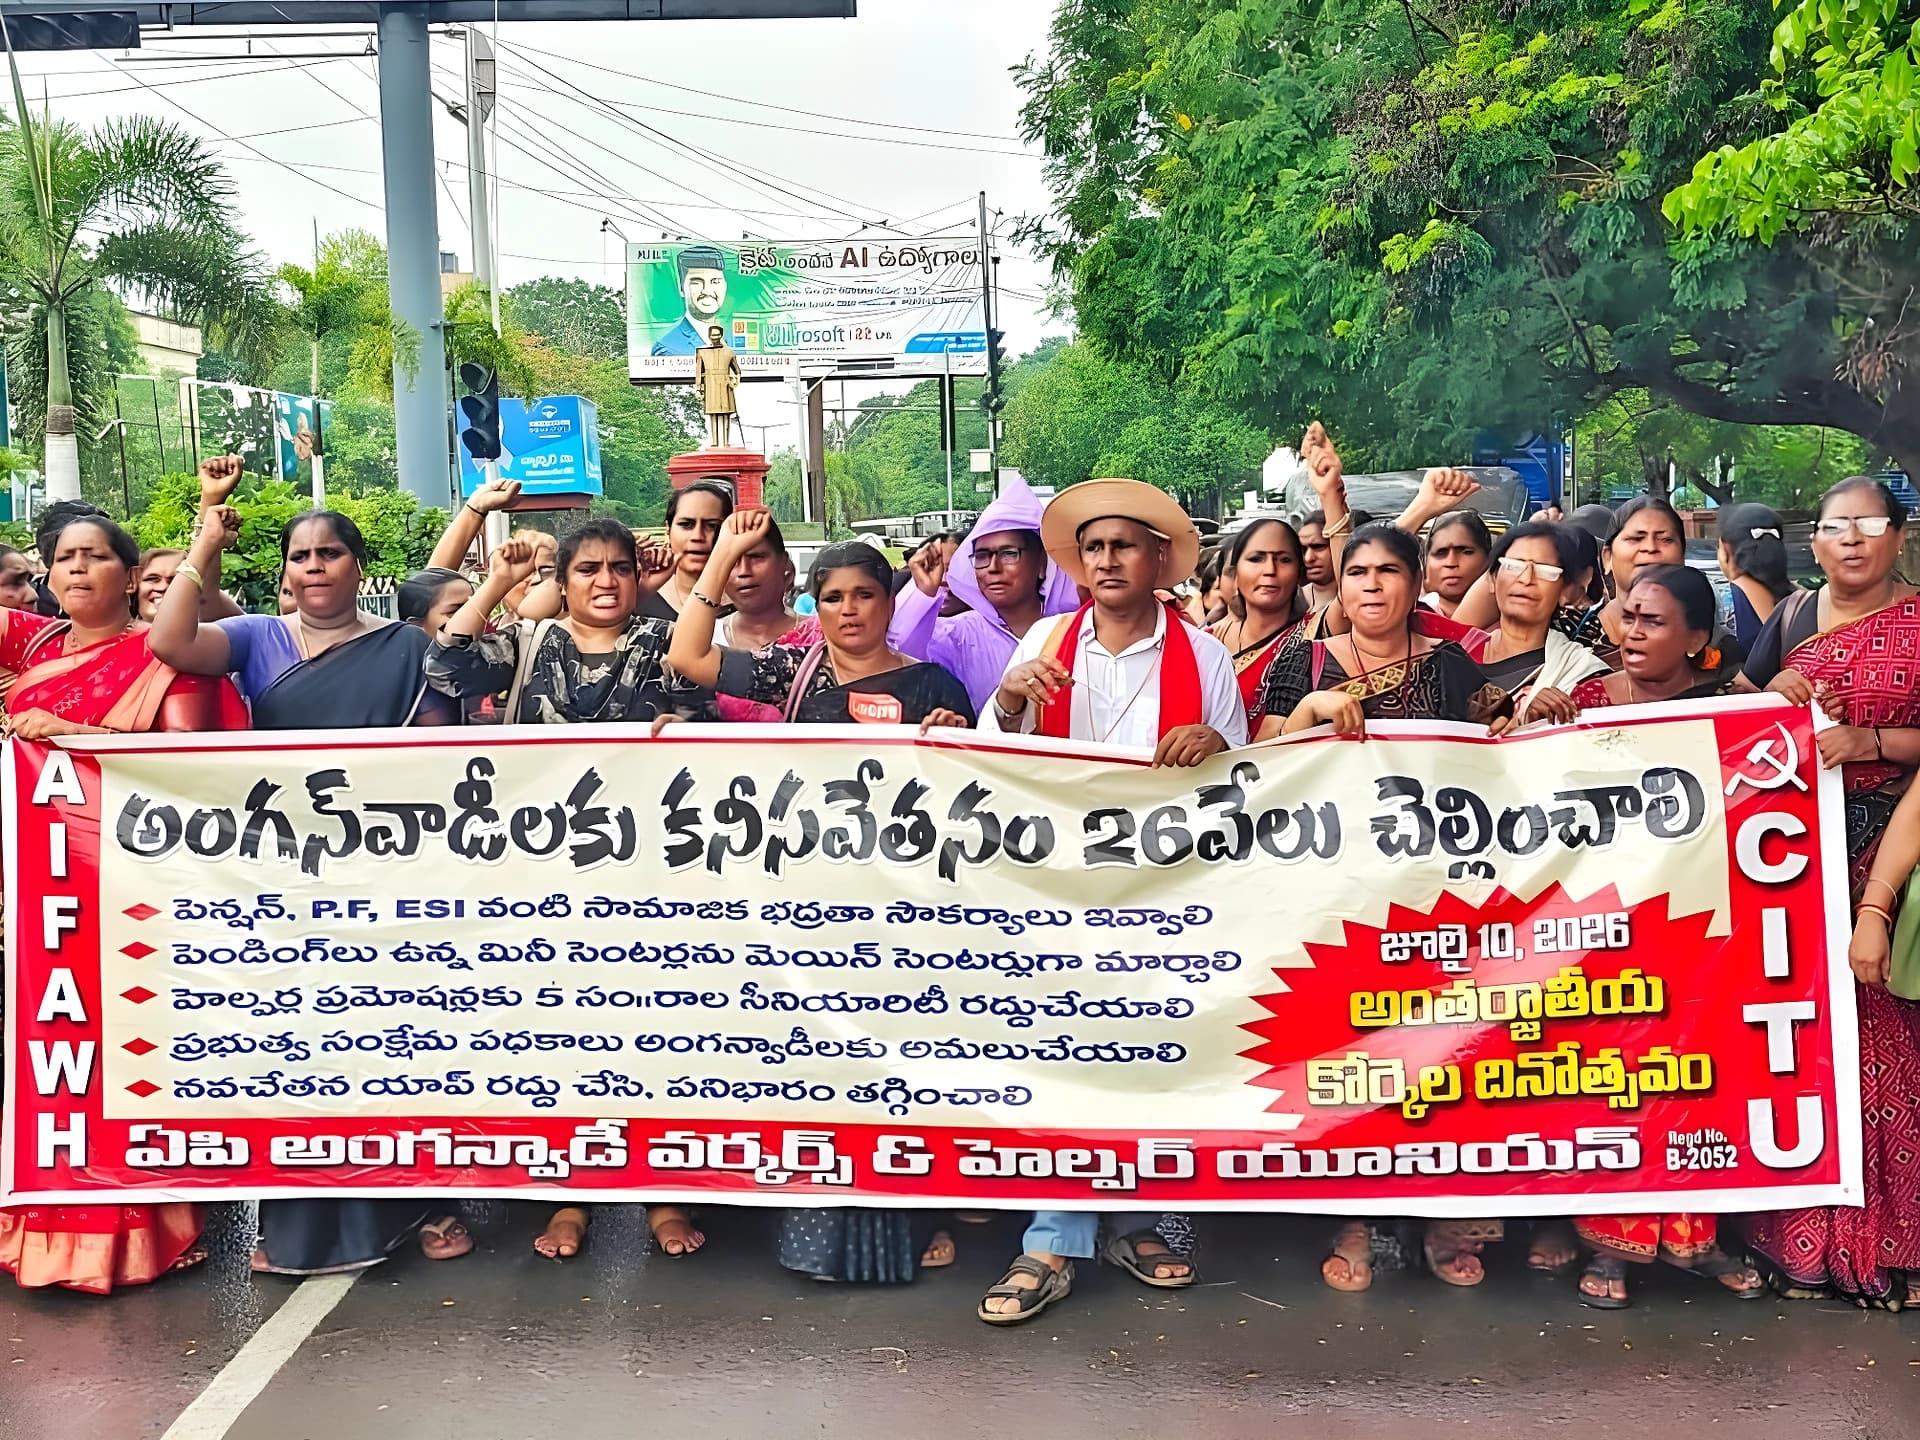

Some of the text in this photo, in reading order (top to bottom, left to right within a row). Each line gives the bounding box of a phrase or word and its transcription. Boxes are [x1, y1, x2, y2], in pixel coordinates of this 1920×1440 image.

[840, 246, 868, 269] AI
[766, 323, 845, 347] rosoft
[1083, 761, 1341, 865] 26వేలు
[1370, 767, 1704, 879] చెల్లించాలి
[479, 894, 571, 917] వంటి
[584, 896, 748, 920] సామాజిక
[761, 902, 874, 929] భద్రతా
[886, 902, 1072, 935] సౌకర్యాలు
[1084, 906, 1212, 935] ఇవ్వాలి
[390, 941, 473, 970] ఉన్న
[478, 938, 556, 962] మినీ
[567, 942, 734, 969] సెంటర్లను
[746, 943, 881, 968] మెయిన్
[892, 948, 1082, 977] సెంటర్లుగా
[1095, 951, 1241, 983] మార్చాలి
[1381, 911, 1630, 973] జూలై 10, 2026
[536, 988, 563, 1007] 5
[1349, 966, 1664, 1041] అంతర్జాతీయ
[170, 1032, 310, 1061] ప్రభుత్వ
[322, 1024, 457, 1060] సంక్షేమ
[174, 1071, 350, 1098] నవచేతన
[362, 1071, 474, 1095] యాప్
[487, 1076, 560, 1107] రద్దు
[667, 1076, 835, 1102] పనిభారం
[847, 1078, 1032, 1115] తగ్గించాలి
[1475, 1041, 1712, 1109] దినోత్సవం
[126, 1119, 1641, 1188] ఏపి అంగన్వాడీ వర్కర్స్ & హెల్పర్ యూనియన్
[1666, 1145, 1739, 1171] B-2052
